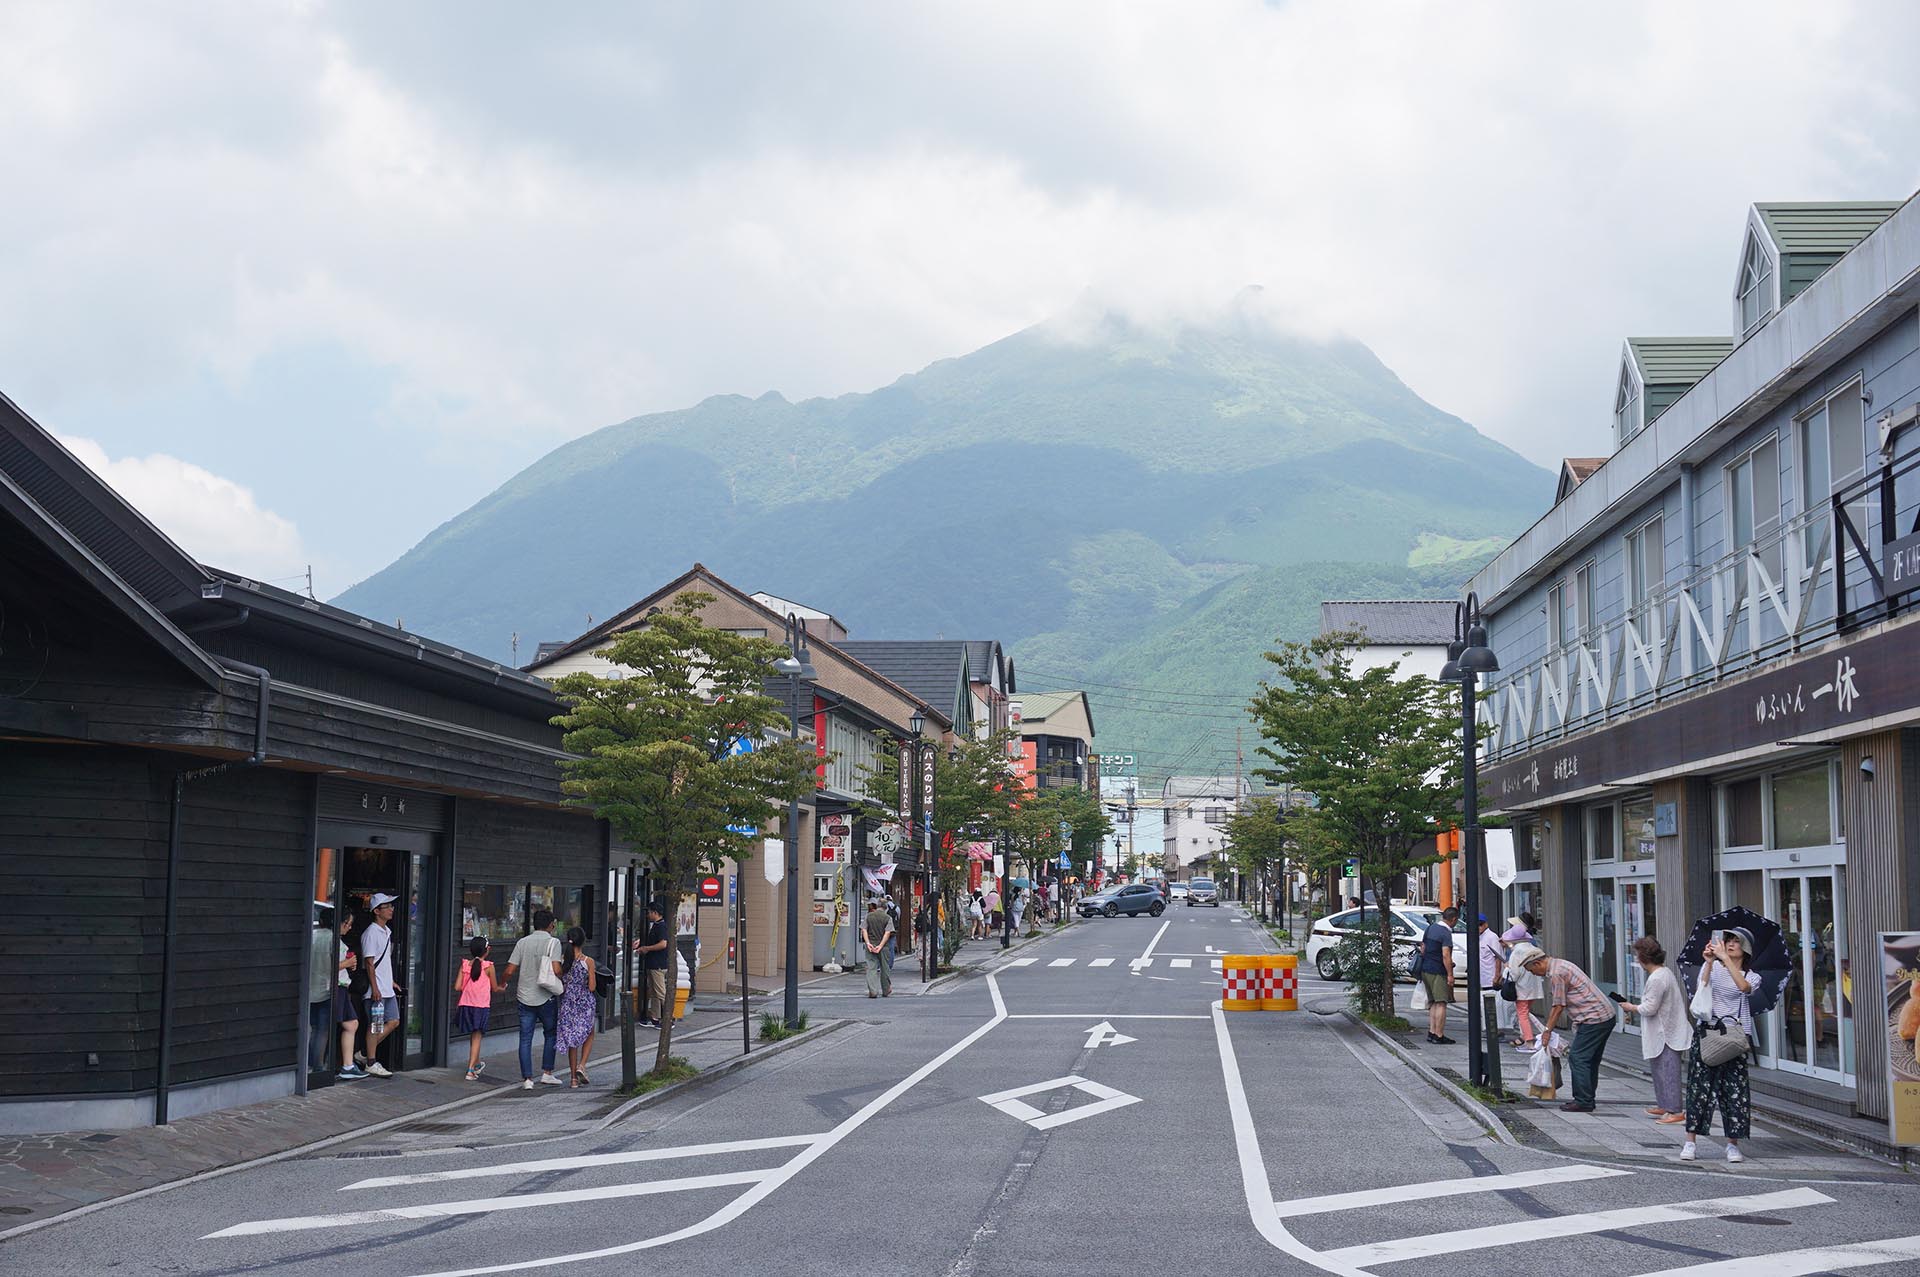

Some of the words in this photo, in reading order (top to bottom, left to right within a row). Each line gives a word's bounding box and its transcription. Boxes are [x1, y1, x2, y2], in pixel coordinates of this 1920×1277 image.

[1893, 550, 1904, 582] 2F
[924, 752, 933, 805] バスのりば
